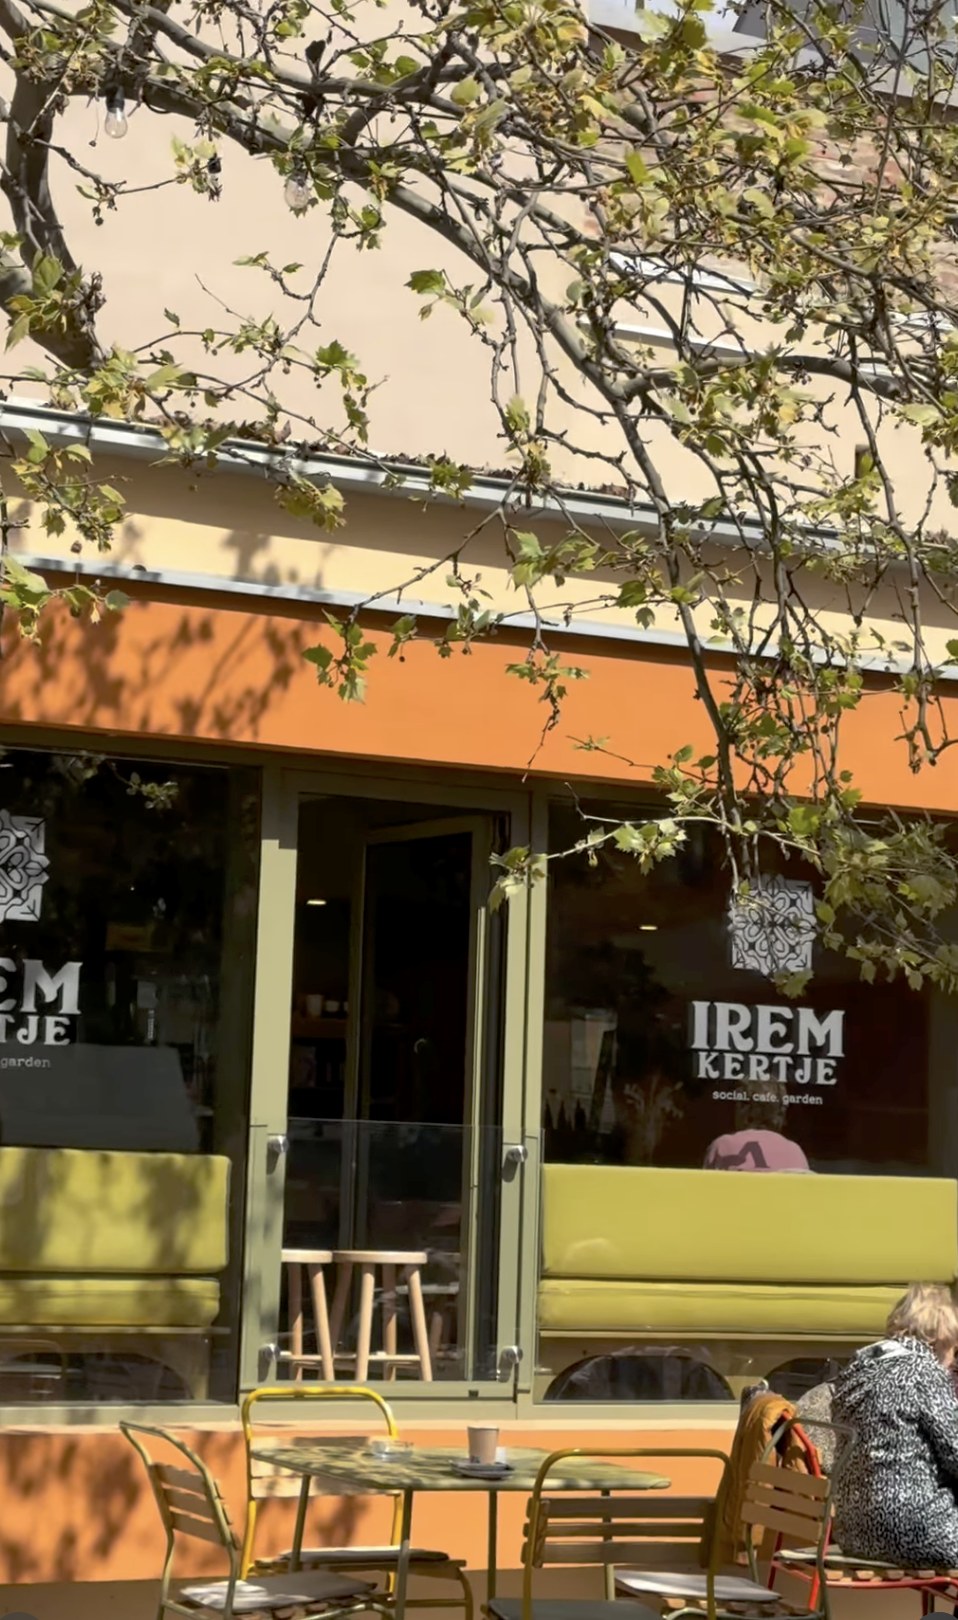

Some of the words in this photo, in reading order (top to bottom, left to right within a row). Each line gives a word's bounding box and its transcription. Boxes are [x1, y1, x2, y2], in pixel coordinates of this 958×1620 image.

[690, 1000, 846, 1058] IREM
[0, 1056, 51, 1069] garden
[697, 1051, 838, 1086] KERTJE
[782, 1093, 823, 1106] garden
